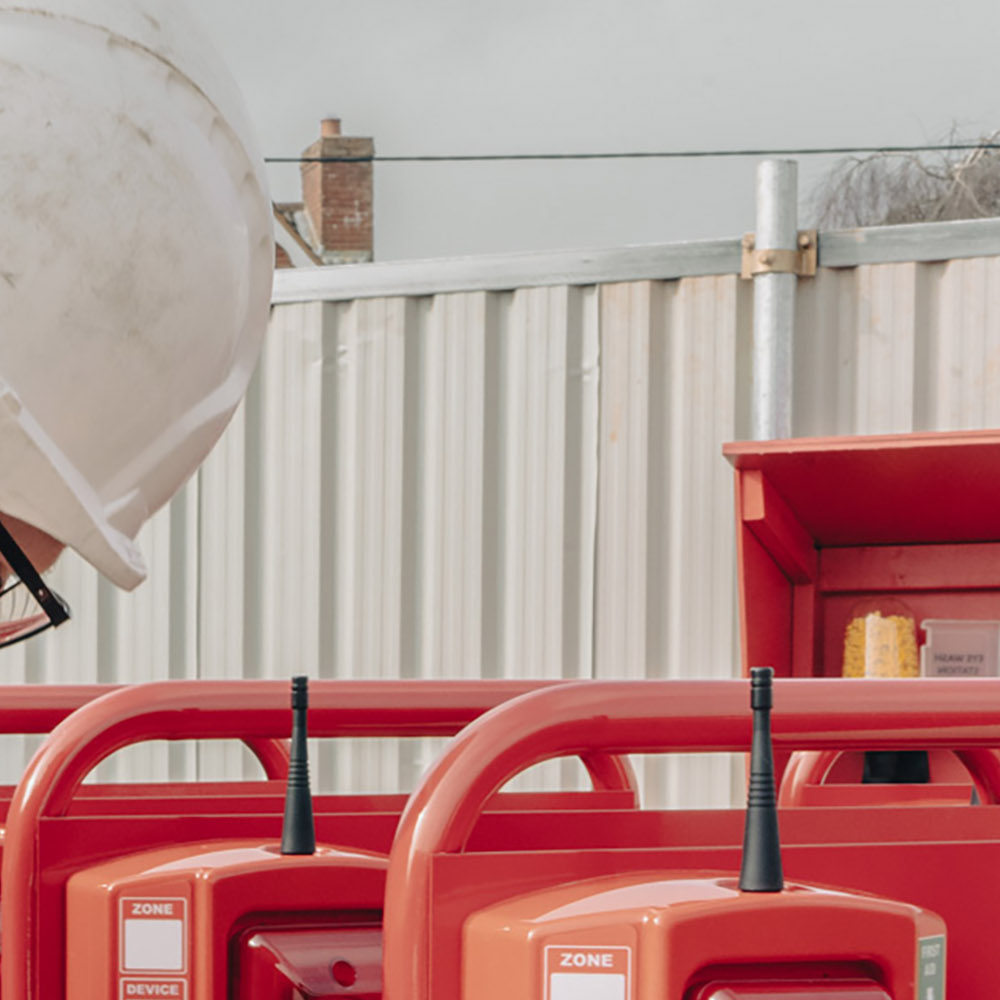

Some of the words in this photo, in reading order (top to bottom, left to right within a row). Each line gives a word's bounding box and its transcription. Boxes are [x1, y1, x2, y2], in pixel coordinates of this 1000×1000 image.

[131, 903, 173, 915] ZONE
[560, 953, 613, 967] ZONE
[126, 984, 179, 995] DEVICE
